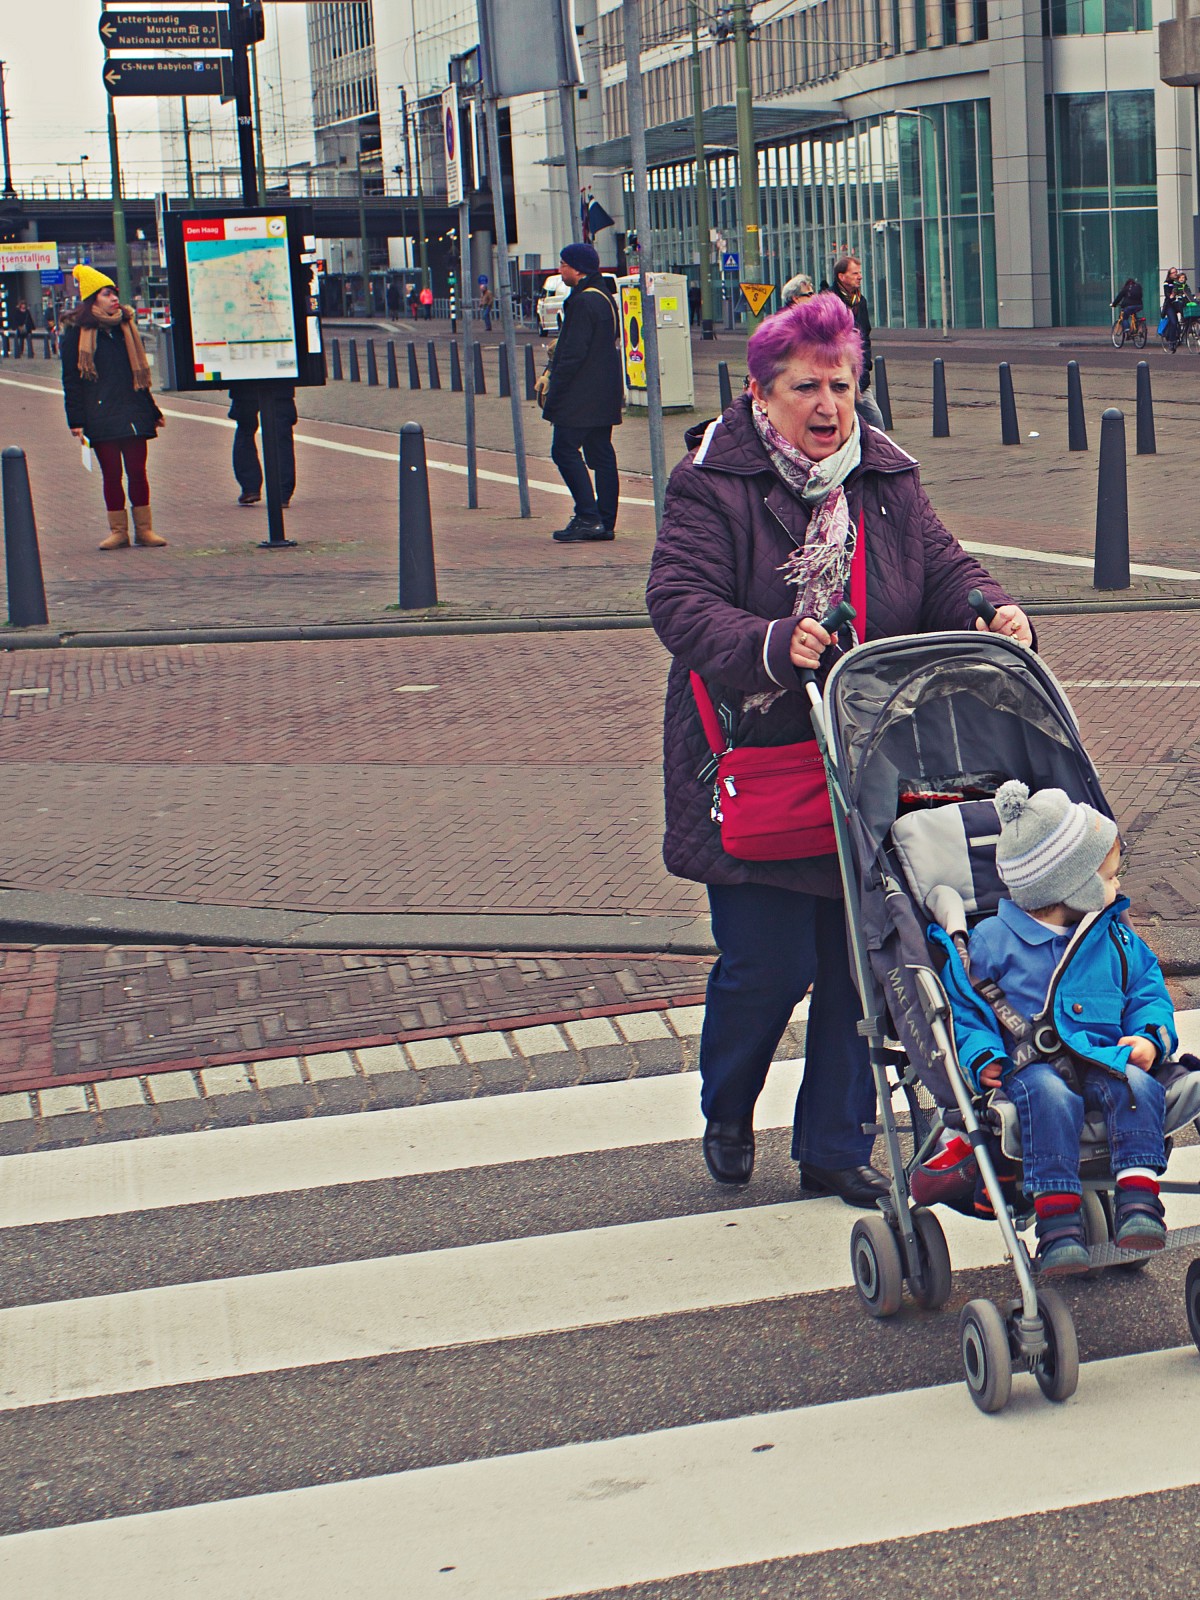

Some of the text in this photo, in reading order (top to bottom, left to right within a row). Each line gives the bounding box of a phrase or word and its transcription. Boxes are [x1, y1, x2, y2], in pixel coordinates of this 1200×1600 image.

[117, 15, 179, 25] Letterkundig
[146, 25, 187, 34] Museum
[119, 36, 164, 44] Nationaal
[167, 35, 200, 44] Archief
[157, 62, 192, 71] Babylon
[201, 226, 219, 234] Haag
[0, 253, 50, 264] tsenstalling
